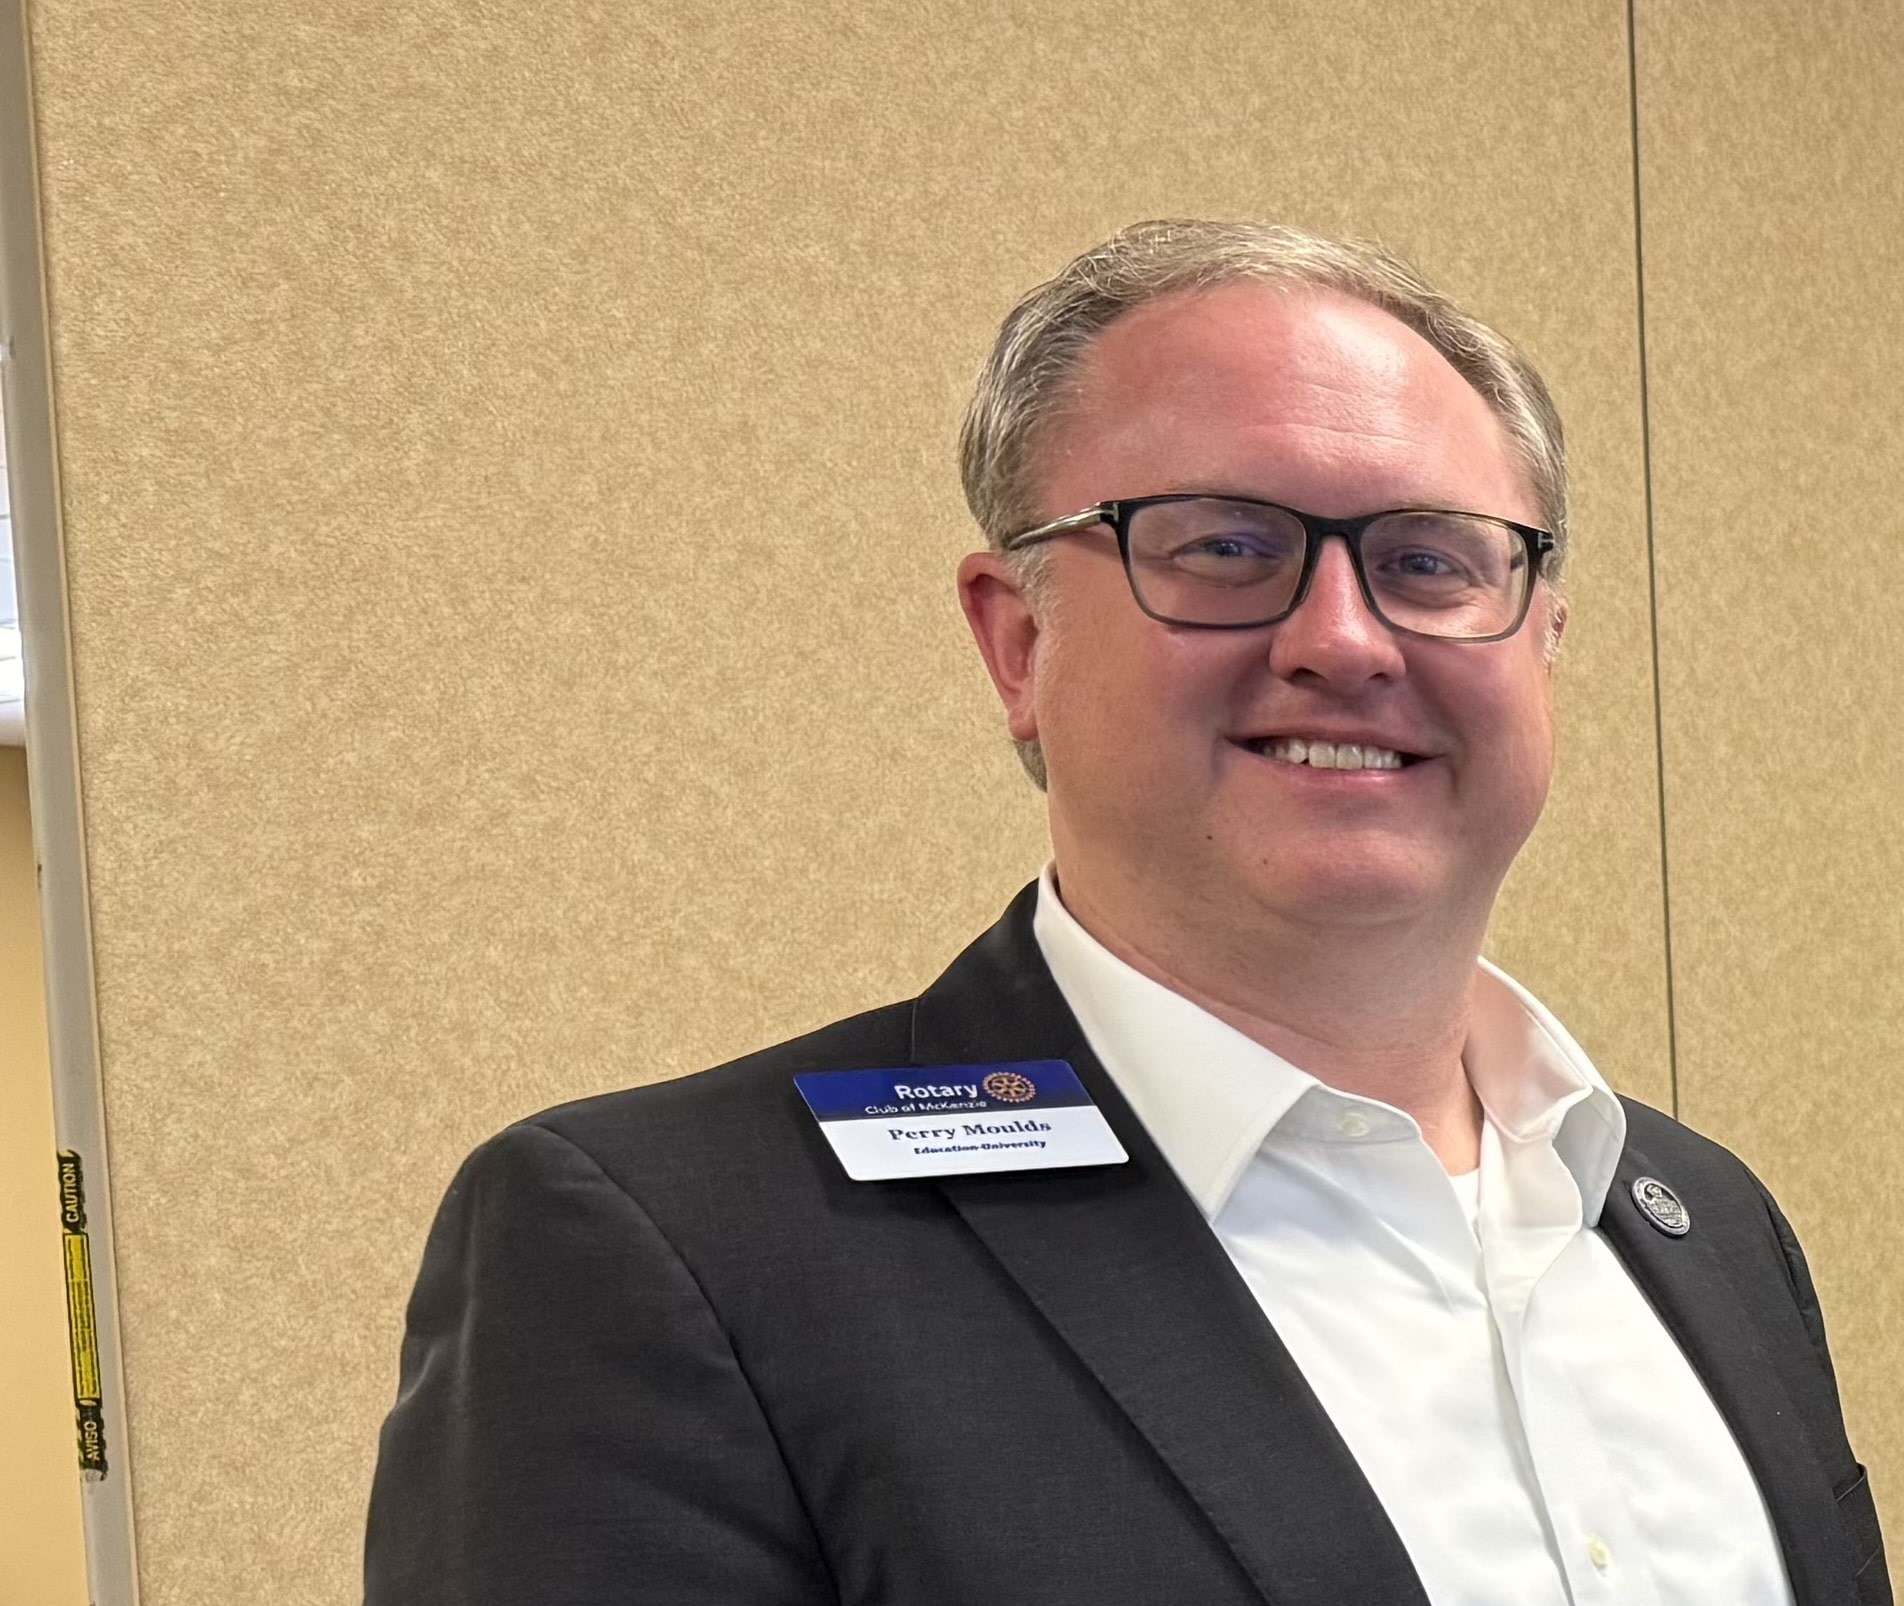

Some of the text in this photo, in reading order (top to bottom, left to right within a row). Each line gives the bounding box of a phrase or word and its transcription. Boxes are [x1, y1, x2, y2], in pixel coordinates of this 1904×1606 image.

[894, 1083, 978, 1101] Rotary
[865, 1104, 898, 1115] Club
[887, 1119, 1053, 1142] Perry Moulds
[62, 1162, 80, 1223] CAUTION
[83, 1419, 100, 1462] AVISO
